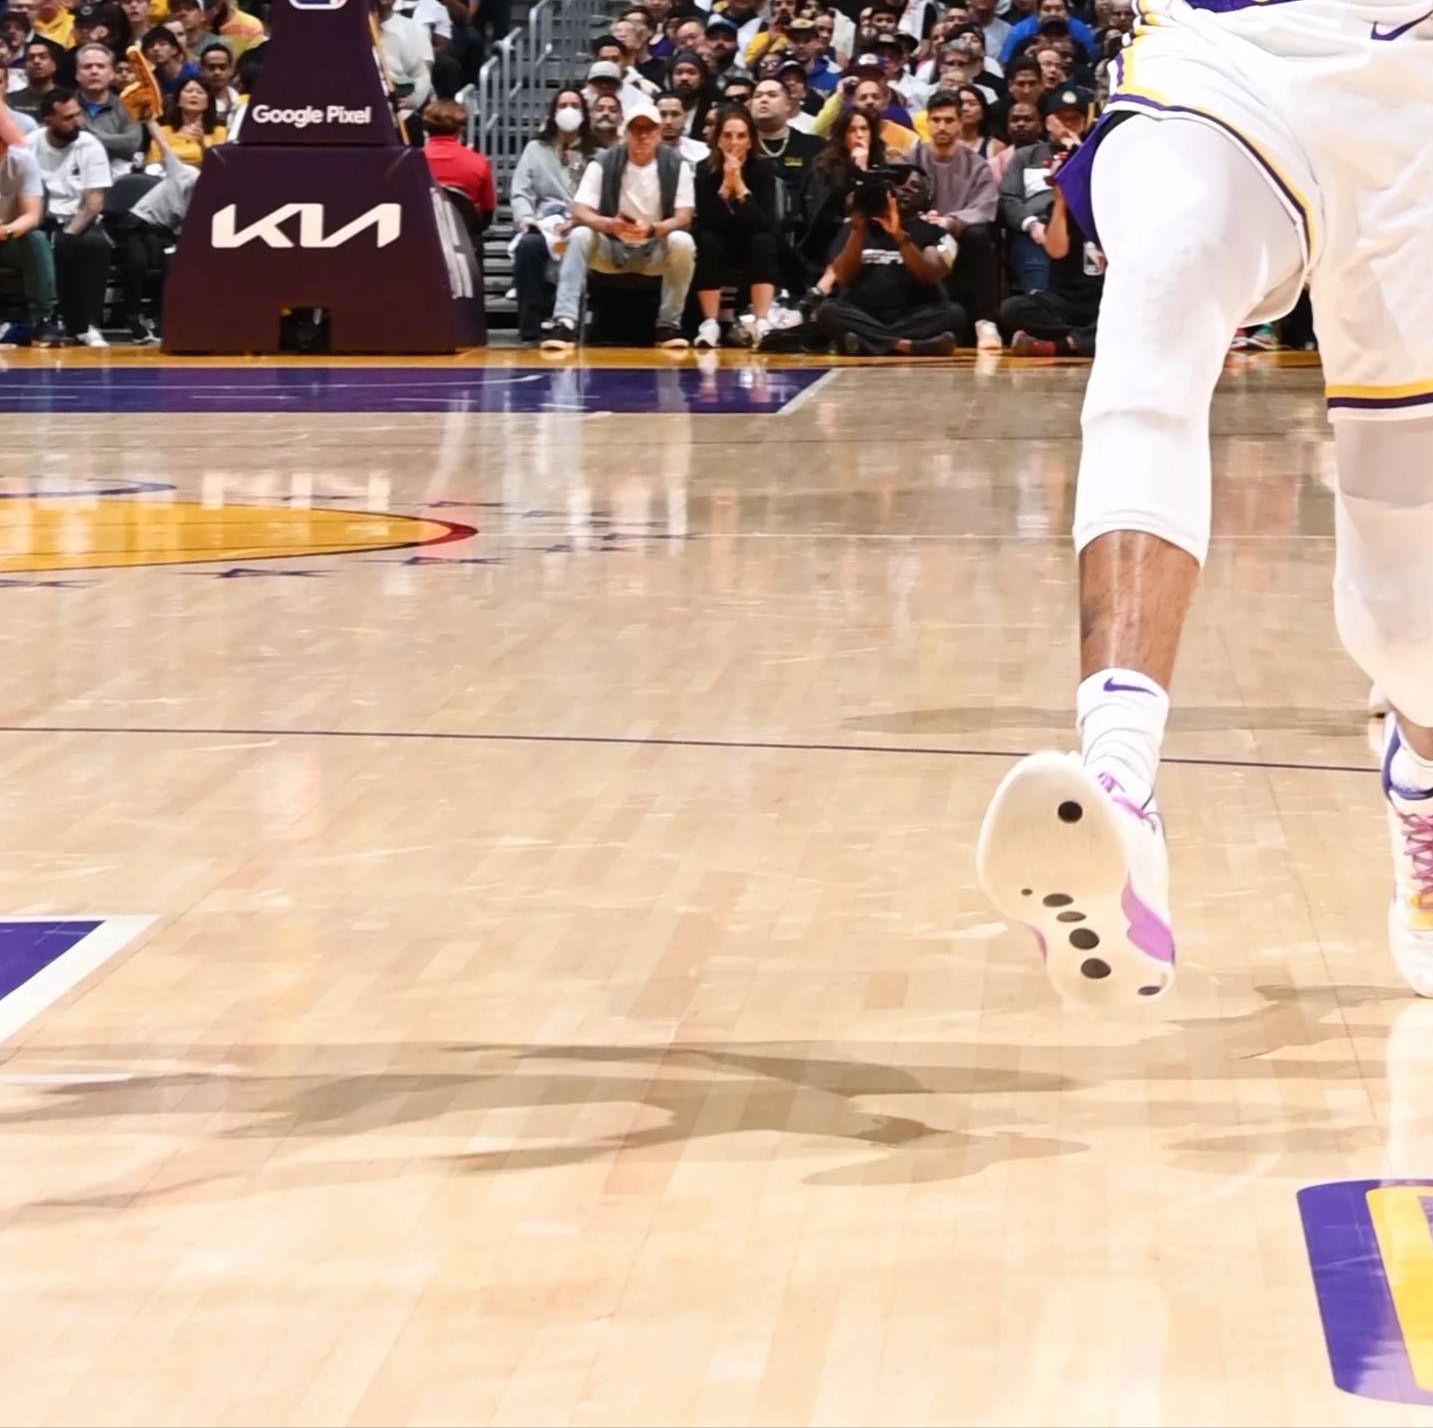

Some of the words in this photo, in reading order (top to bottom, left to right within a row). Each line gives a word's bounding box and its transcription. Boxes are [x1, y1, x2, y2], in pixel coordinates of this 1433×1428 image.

[252, 104, 325, 129] Google
[326, 105, 372, 125] Pixel
[211, 203, 402, 249] KIA
